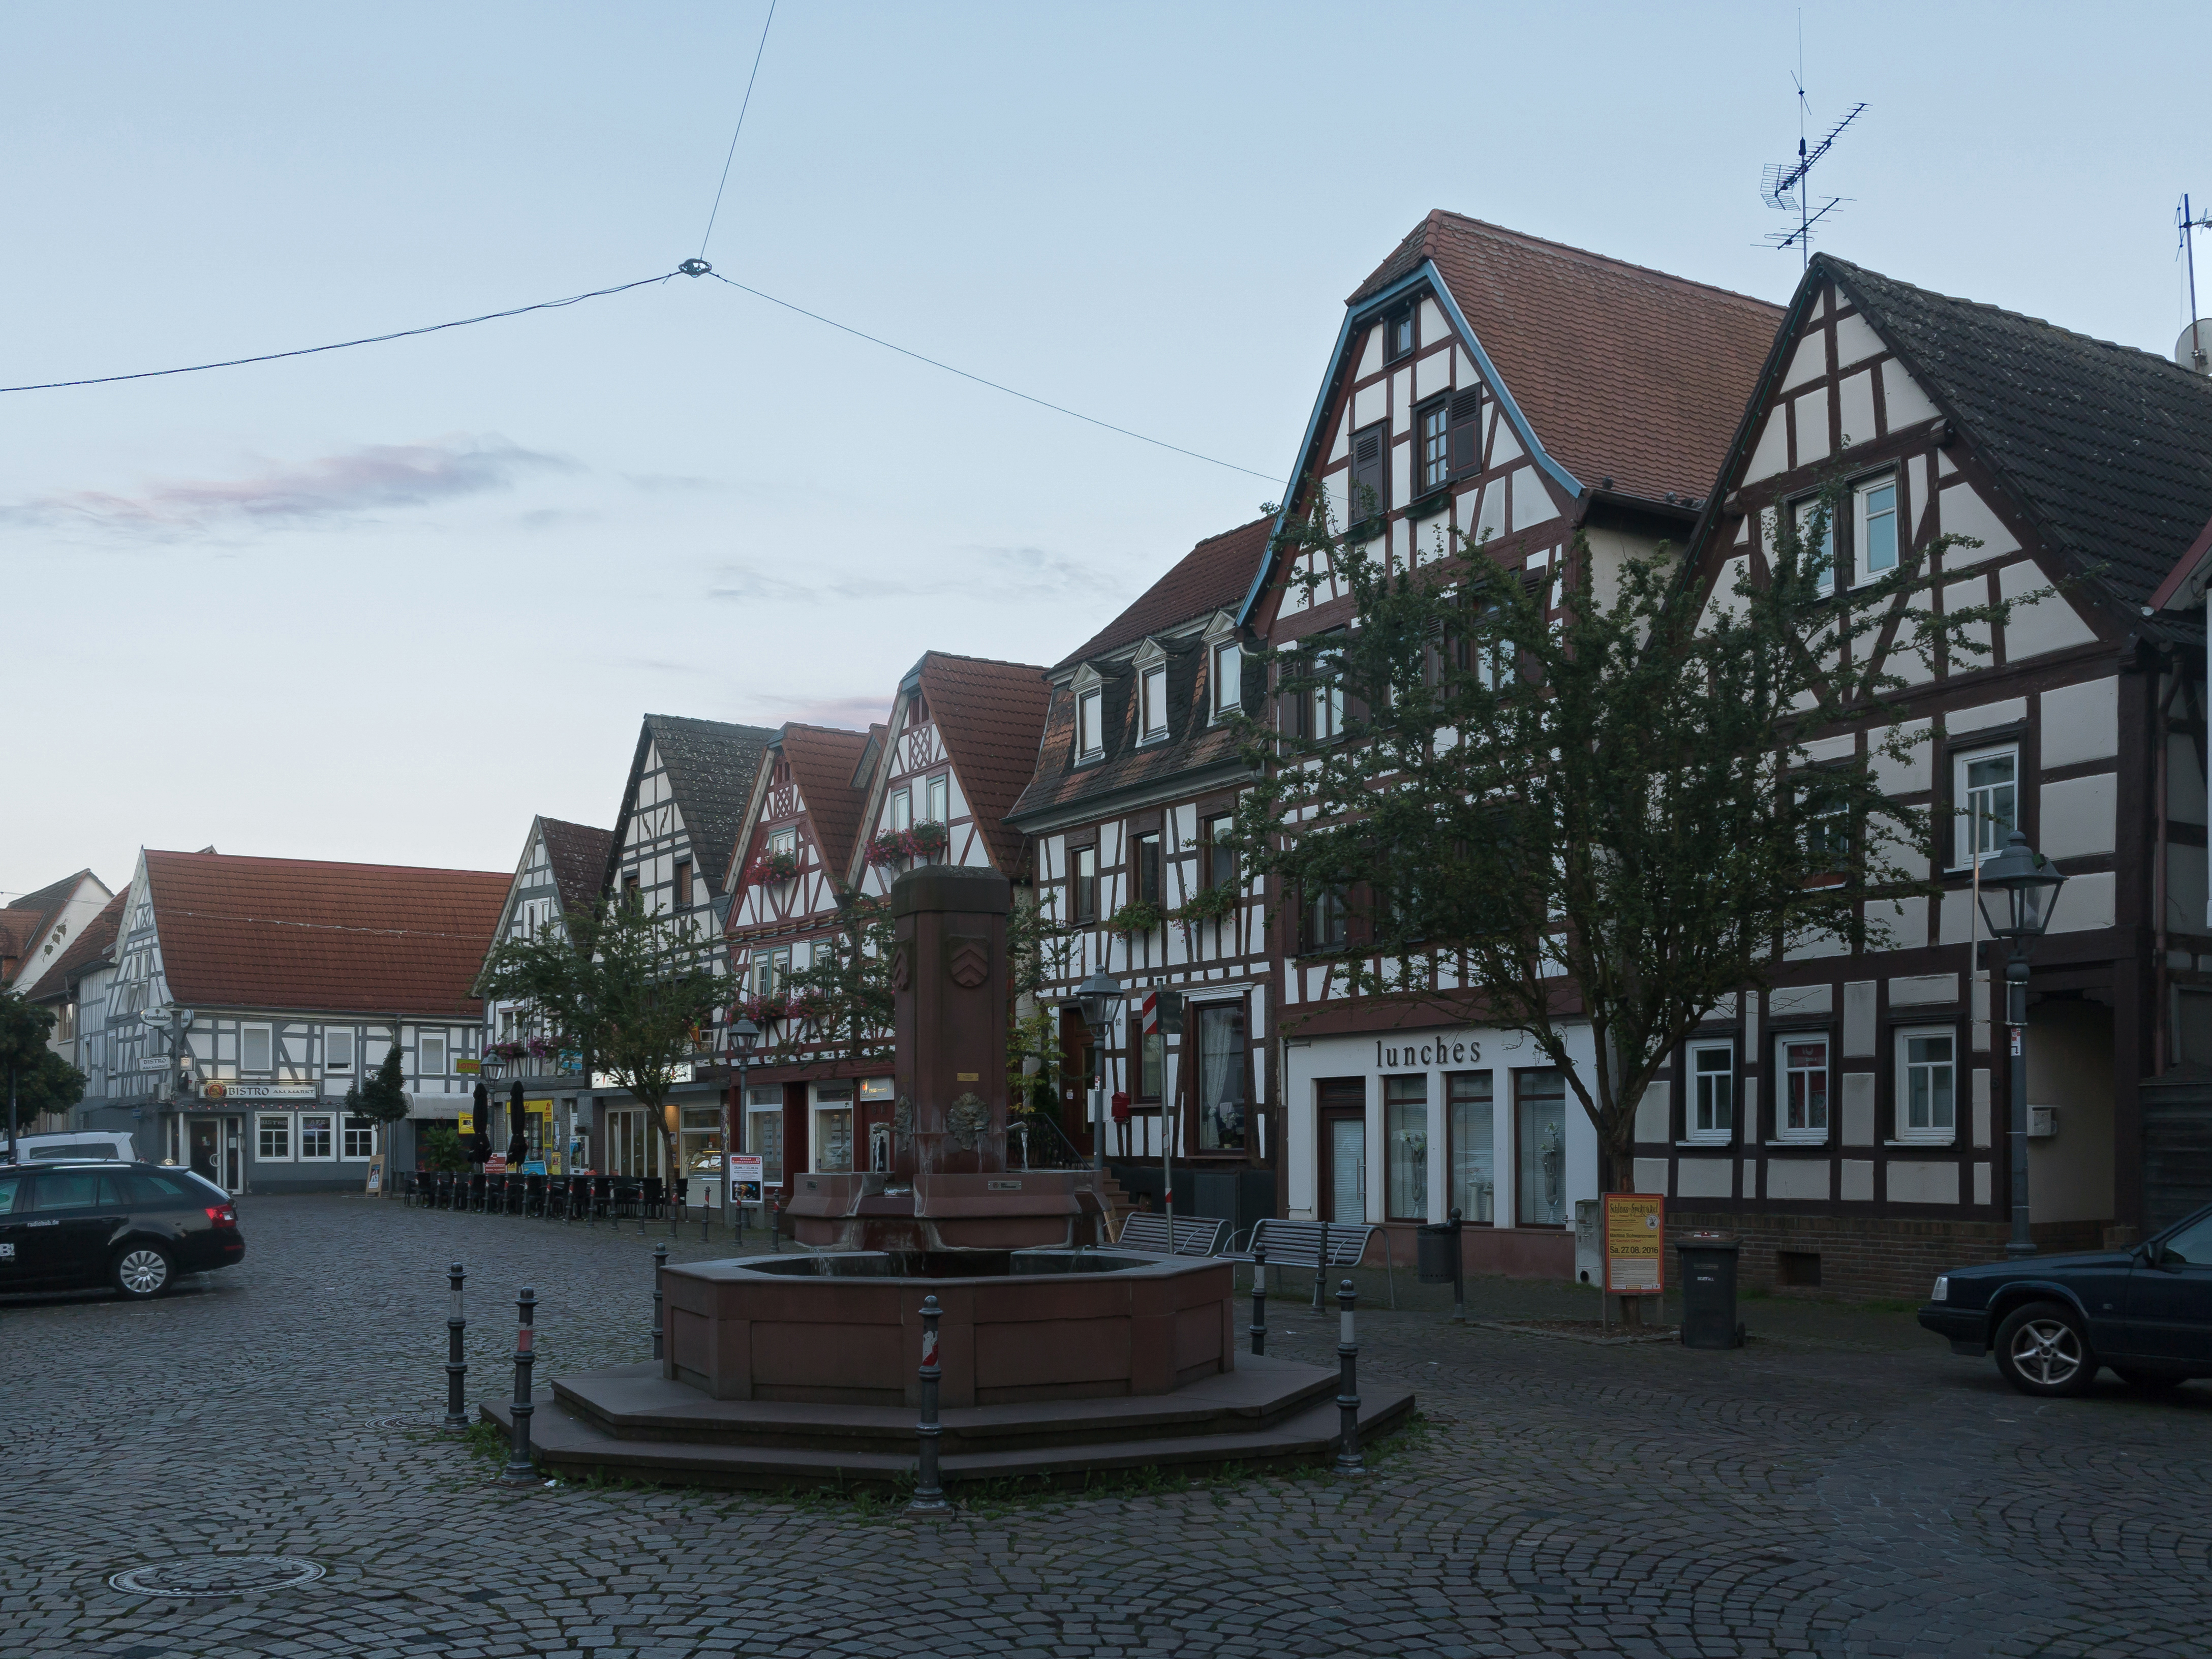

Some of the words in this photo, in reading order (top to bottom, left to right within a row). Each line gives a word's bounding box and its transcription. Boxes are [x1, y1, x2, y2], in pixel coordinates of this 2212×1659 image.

[1115, 1018, 1122, 1026] 12
[1376, 1035, 1481, 1067] lunches
[228, 1087, 269, 1096] BISTRO
